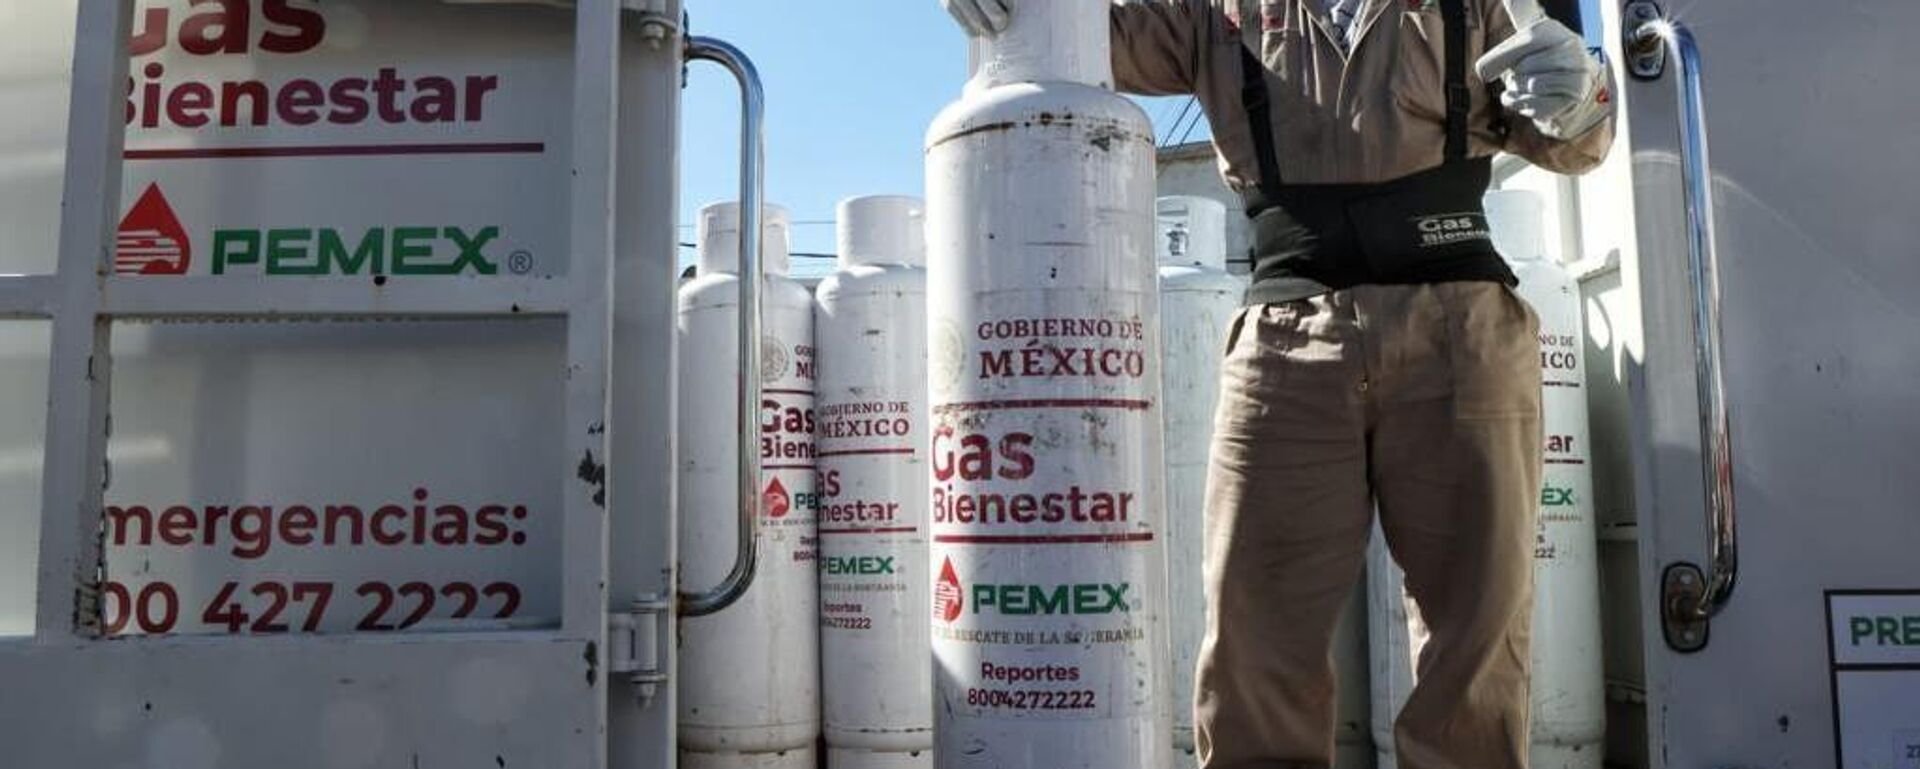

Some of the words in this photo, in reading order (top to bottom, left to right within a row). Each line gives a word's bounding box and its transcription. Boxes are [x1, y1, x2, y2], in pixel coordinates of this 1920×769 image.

[1418, 217, 1473, 232] Gas
[211, 225, 499, 275] PEMEX
[978, 318, 1112, 340] GOBIERNO
[1119, 320, 1143, 340] DE
[979, 339, 1144, 379] MÉXICO
[762, 400, 815, 433] Gas
[888, 401, 910, 414] DE
[932, 426, 1035, 482] Gas
[934, 484, 1133, 524] Bienestar
[203, 581, 333, 633] 427
[972, 582, 1129, 615] PEMEX
[1014, 629, 1037, 645] DE
[1040, 629, 1060, 645] LA
[981, 661, 1080, 684] Reportes
[967, 687, 1095, 710] 8004272222
